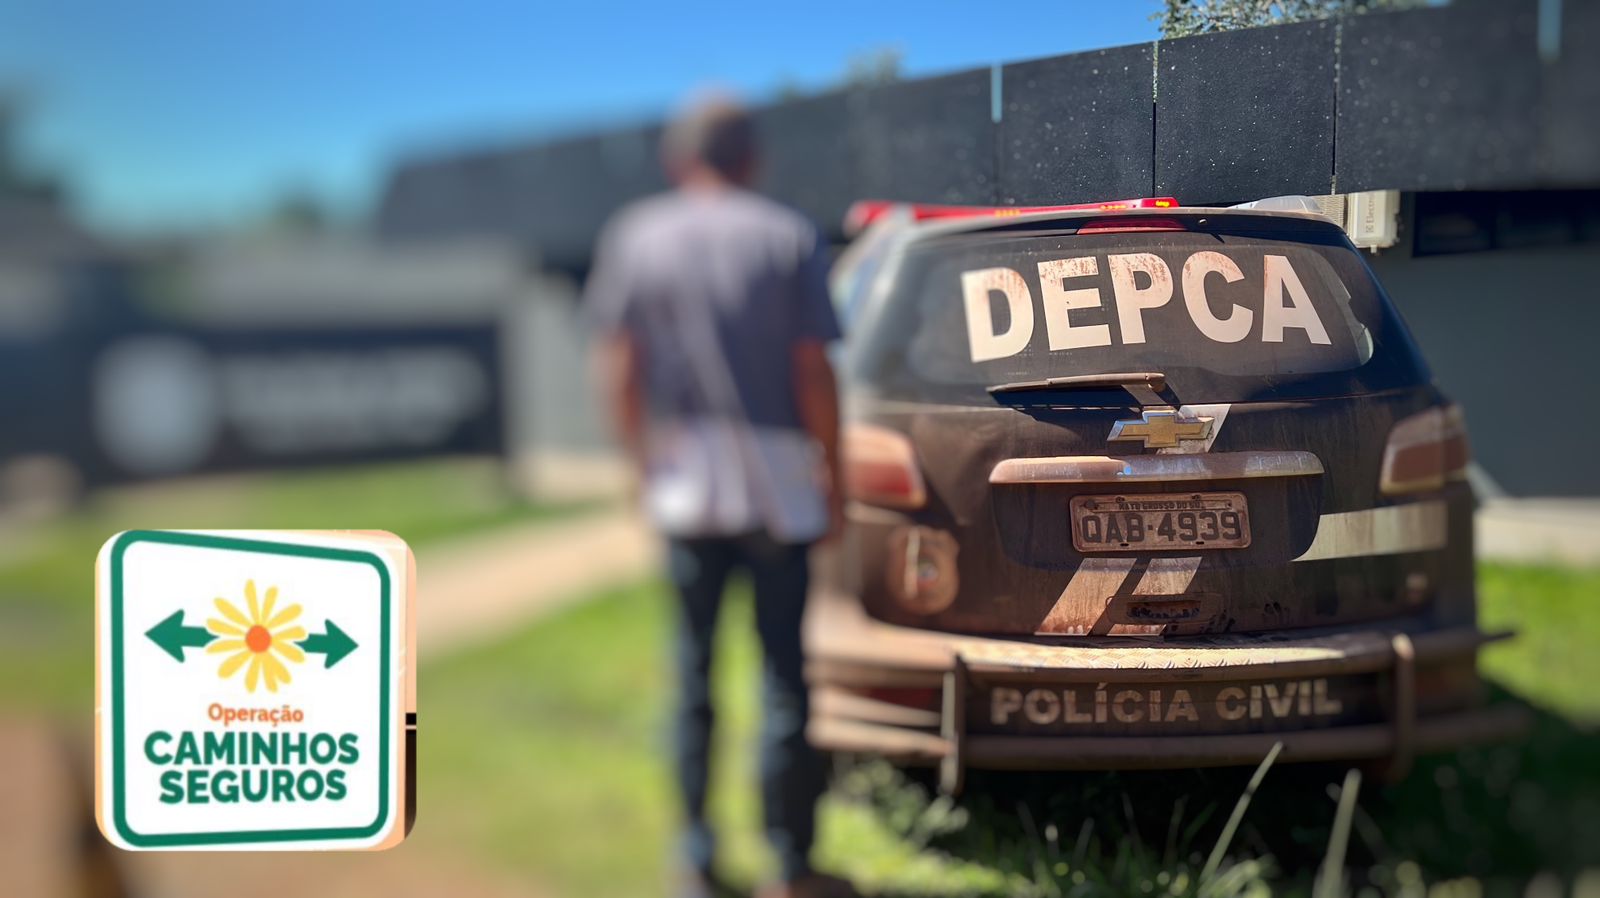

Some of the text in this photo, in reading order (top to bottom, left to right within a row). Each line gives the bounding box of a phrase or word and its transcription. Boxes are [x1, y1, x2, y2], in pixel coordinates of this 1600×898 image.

[961, 251, 1332, 363] DEPCA
[990, 678, 1343, 725] POLÍCIA CIVIL
